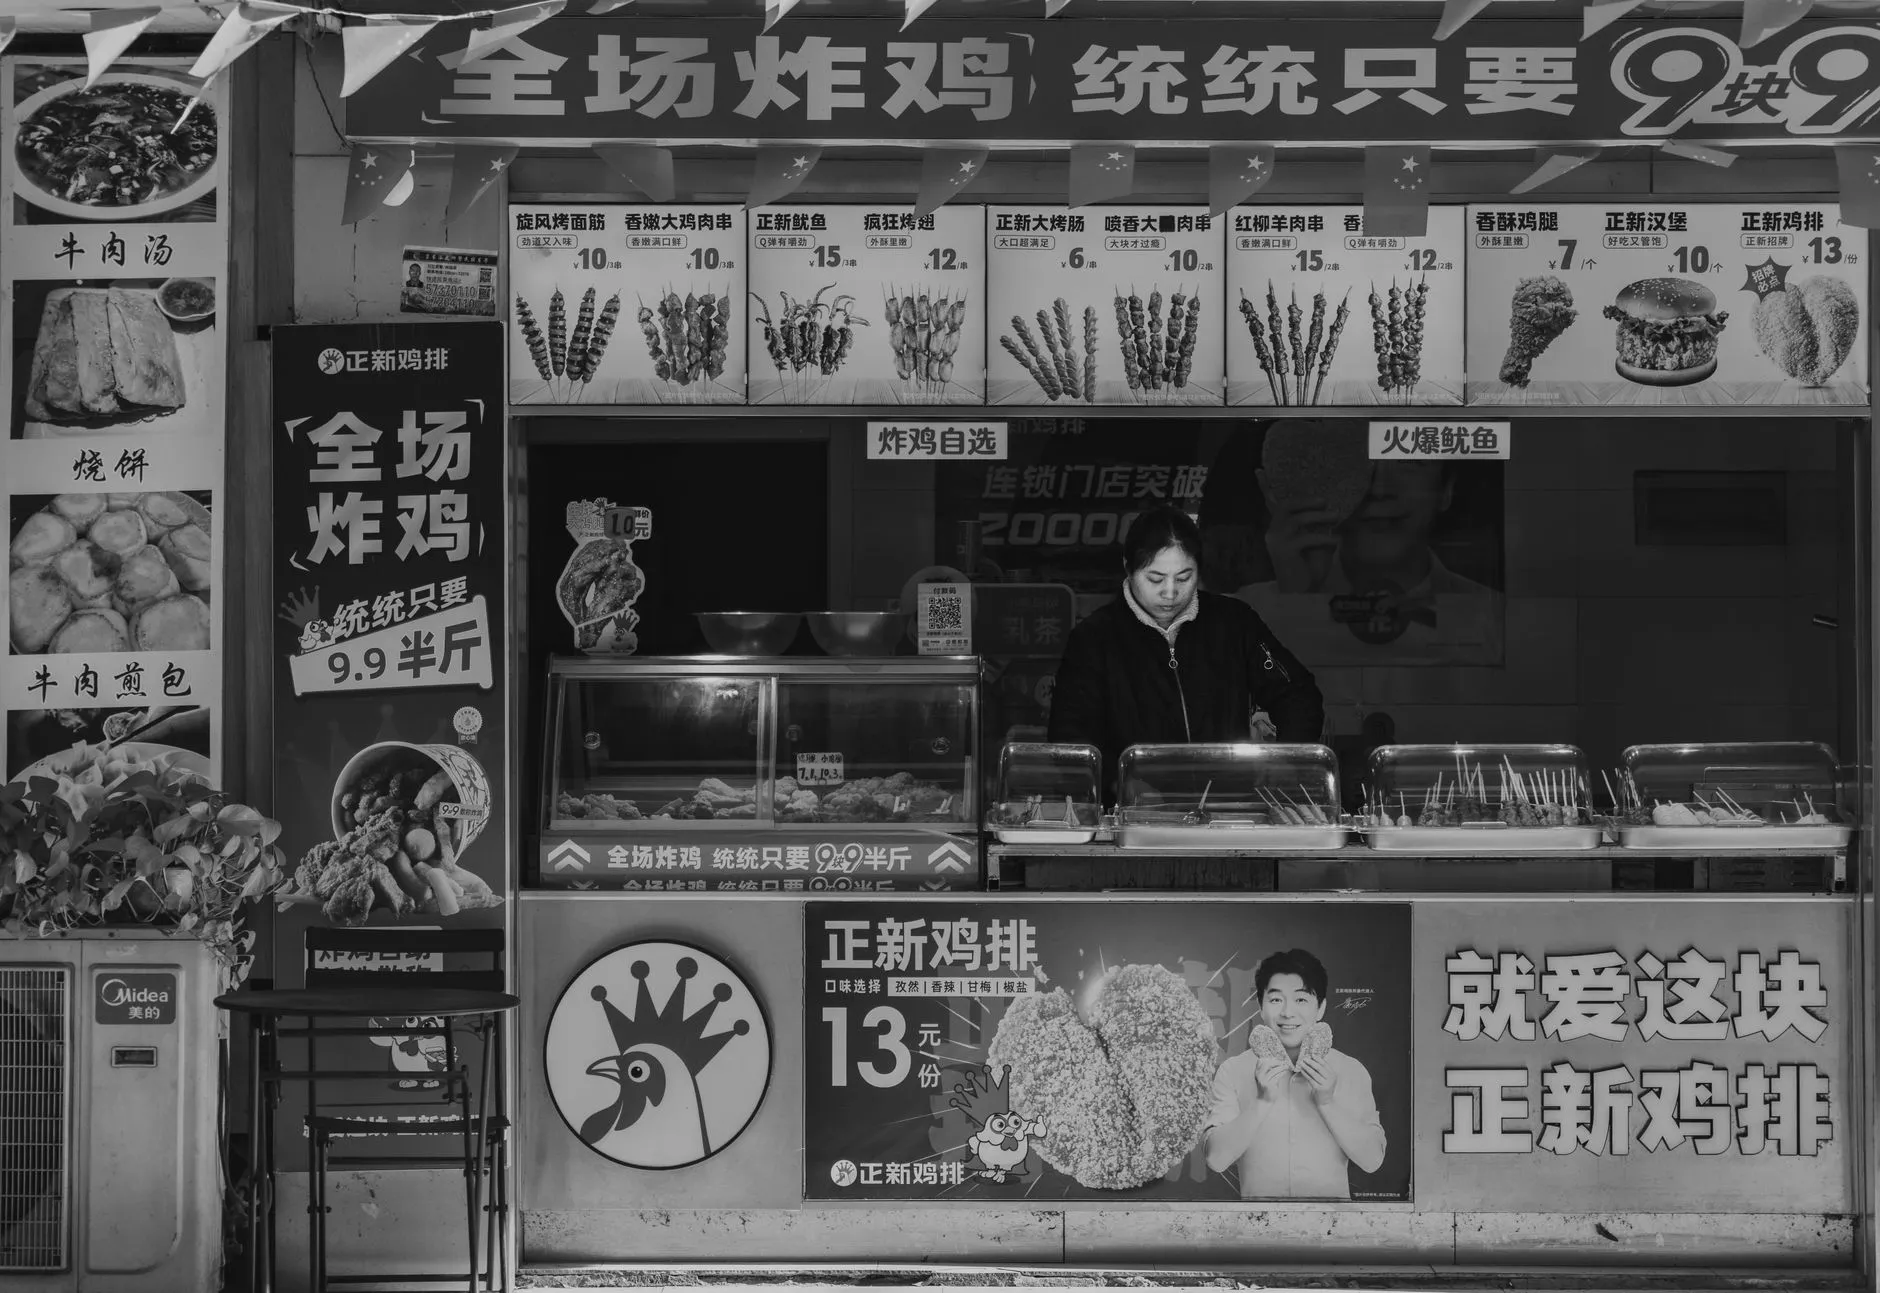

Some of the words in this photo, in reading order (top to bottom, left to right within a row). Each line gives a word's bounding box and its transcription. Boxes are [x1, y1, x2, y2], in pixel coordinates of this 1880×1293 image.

[436, 34, 1013, 121] 全场炸鸡
[516, 213, 606, 231] 旋风烤面筋
[625, 213, 732, 231] 香嫩大鸡肉串
[756, 213, 827, 231] 正新鱿鱼
[996, 214, 1085, 232] 正新大烤肠
[1104, 214, 1211, 233] 喷香大肉串
[1235, 214, 1324, 232] 红柳羊肉串
[1476, 211, 1558, 231] 香酥鸡腿
[1605, 211, 1687, 231] 正新汉堡
[1741, 211, 1824, 231] 正新鸡排
[54, 231, 173, 271] 牛肉汤
[521, 236, 573, 247] 劲道又入味
[999, 238, 1049, 248] 大口超满足
[1110, 239, 1160, 249] 大块才过瘾
[1481, 236, 1523, 246] 外酥里嫩
[1608, 236, 1662, 246] 好吃又管饱
[1745, 236, 1788, 246] 正新招牌
[1751, 264, 1776, 283] 招牌
[1757, 277, 1780, 294] 必点
[346, 348, 449, 372] 正新鸡排
[306, 410, 471, 482] 全场
[878, 426, 997, 456] 炸鸡自选
[1381, 426, 1500, 454] 火爆鱿鱼
[73, 448, 149, 483] 烧饼
[982, 464, 1208, 499] 连锁门店突破
[306, 489, 470, 565] 炸鸡
[332, 576, 468, 639] 统统只要
[27, 661, 191, 703] 牛肉煎包
[607, 845, 702, 870] 全场炸鸡
[821, 917, 1038, 972] 正新鸡排
[111, 987, 168, 1002] Midea
[825, 979, 881, 994] 口味选择
[1442, 946, 1829, 1042] 就爱这块
[128, 1006, 160, 1019] 美的
[822, 1005, 912, 1088] 13
[1442, 1060, 1833, 1156] 正新鸡排
[860, 1162, 965, 1185] 正新鸡排
